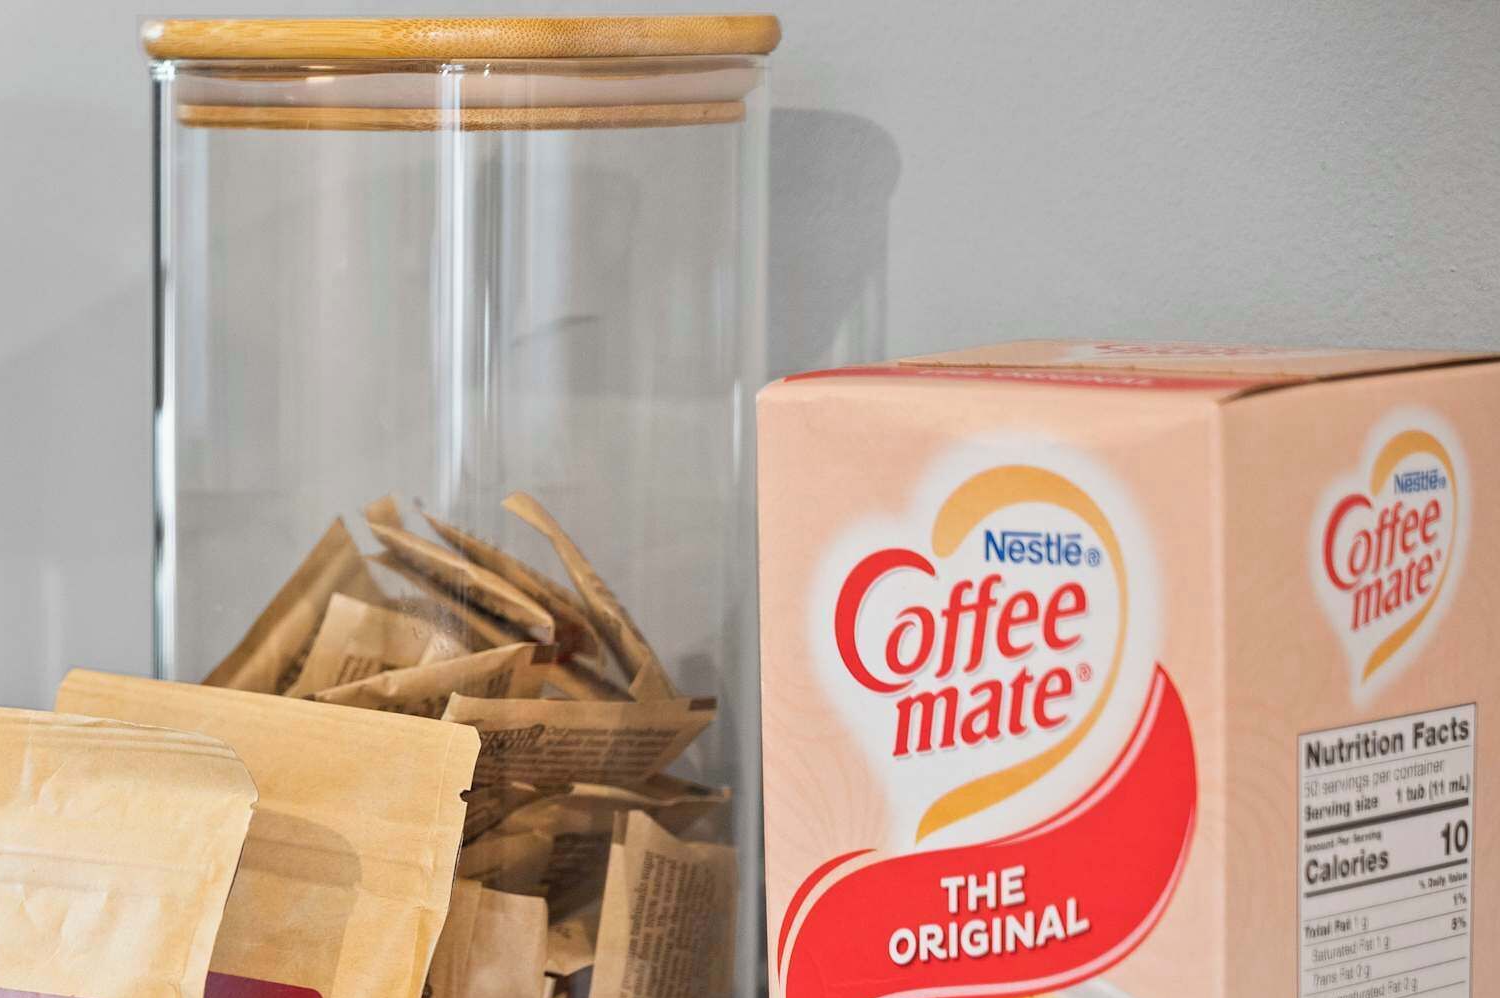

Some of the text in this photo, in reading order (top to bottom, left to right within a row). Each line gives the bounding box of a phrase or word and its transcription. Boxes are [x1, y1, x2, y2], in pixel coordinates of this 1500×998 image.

[984, 529, 1083, 567] Nestlé
[1322, 494, 1441, 591] Coffee
[834, 548, 1088, 694] Coffee
[1352, 551, 1433, 631] mate
[892, 662, 1074, 757] mate
[1305, 717, 1469, 770] Nutrition Facts
[1322, 771, 1369, 795] servings
[1372, 769, 1391, 786] per
[1393, 758, 1444, 781] container
[1304, 800, 1350, 822] Serving
[1354, 795, 1379, 813] size
[1406, 784, 1425, 801] tub
[1305, 819, 1469, 886] Calories 10
[941, 865, 1026, 914] THE
[889, 897, 1090, 965] ORIGINAL
